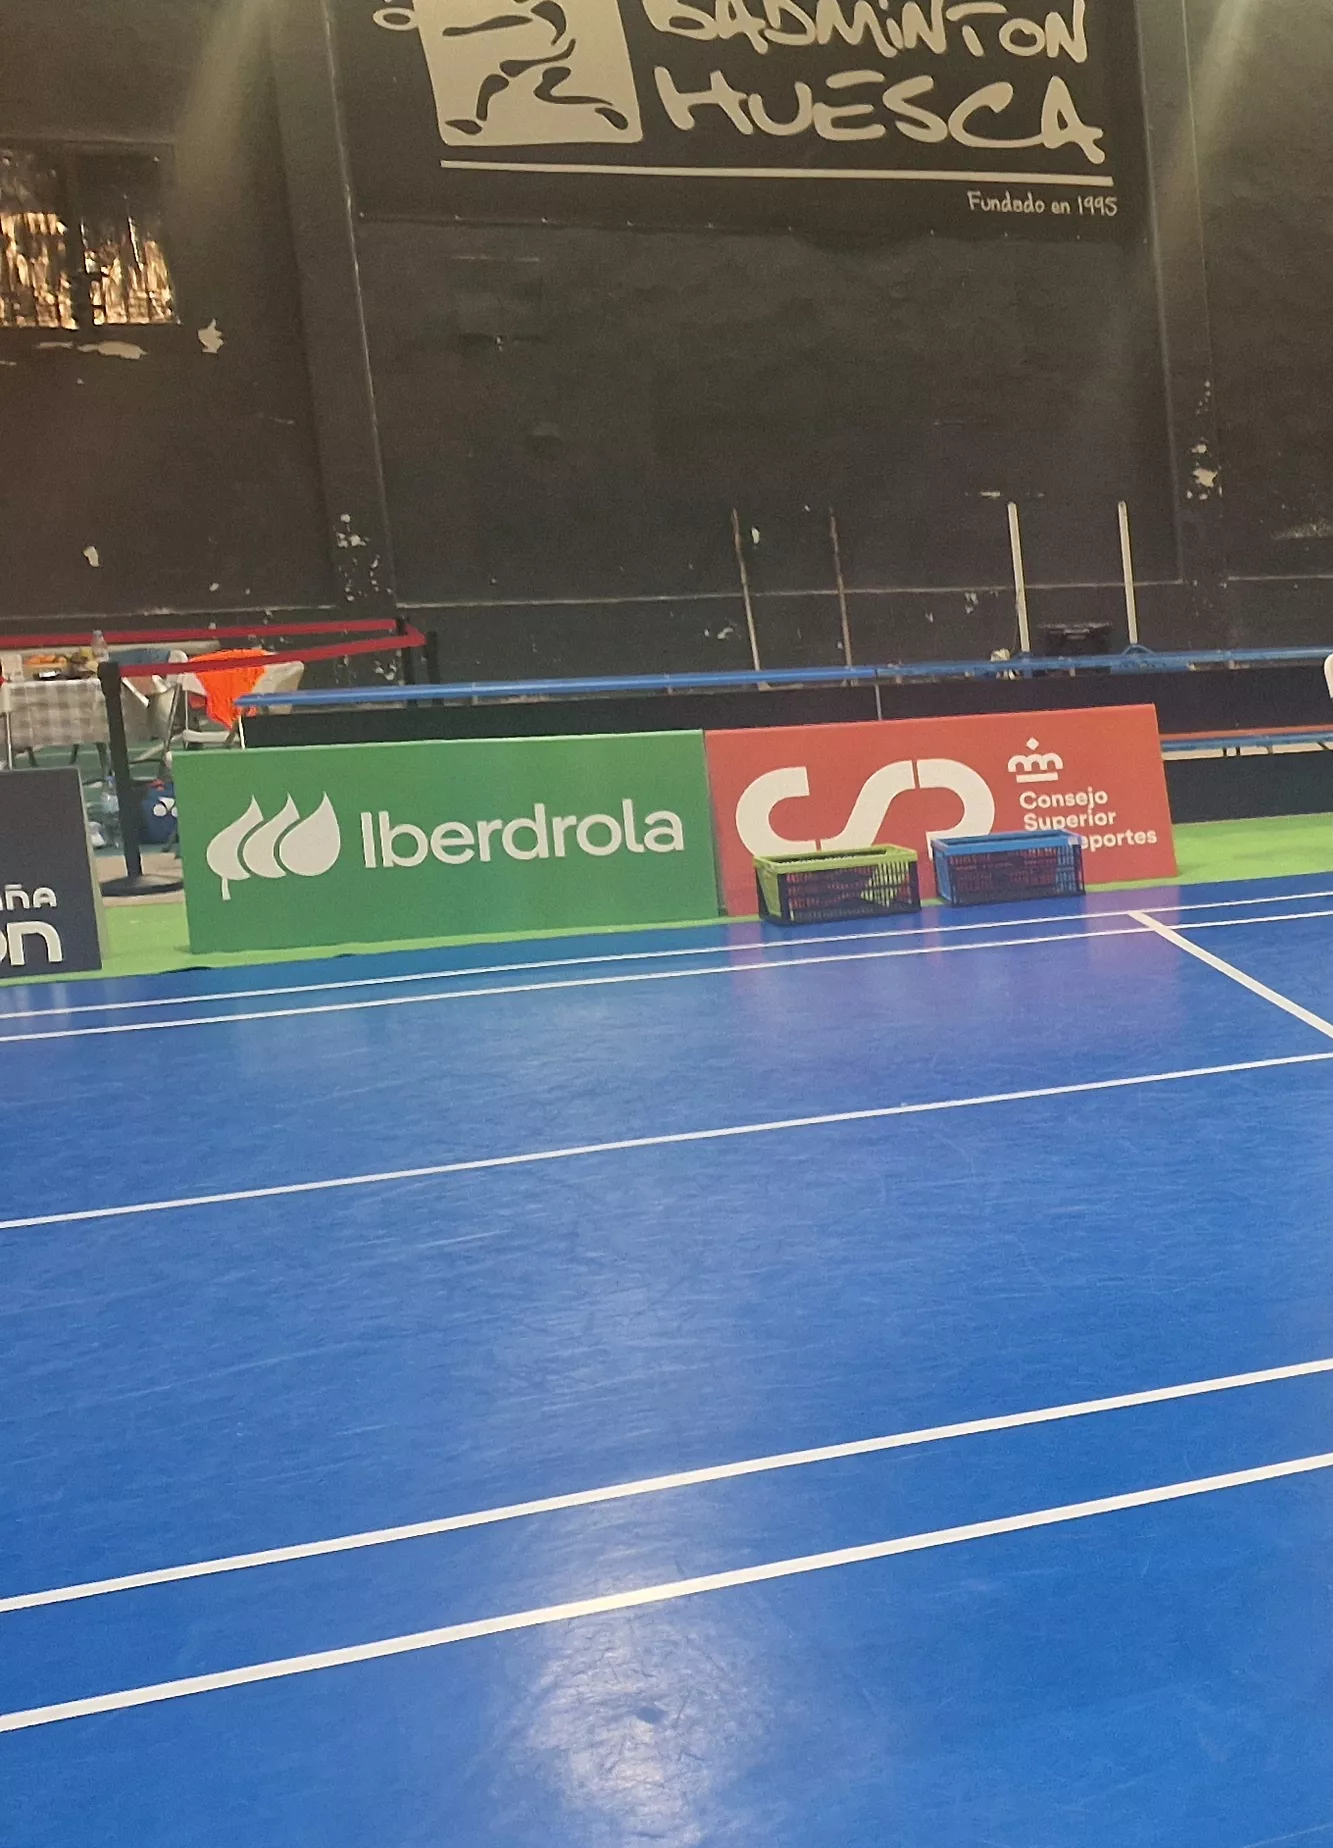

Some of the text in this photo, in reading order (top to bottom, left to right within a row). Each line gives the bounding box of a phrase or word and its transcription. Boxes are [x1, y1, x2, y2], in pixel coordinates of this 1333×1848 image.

[653, 65, 1106, 165] HUESCA
[967, 190, 1118, 217] Fundado en 1995
[1019, 786, 1108, 810] Consejo
[1023, 809, 1117, 831] Superior
[361, 798, 685, 868] Iberdrola
[1081, 829, 1158, 852] eportes
